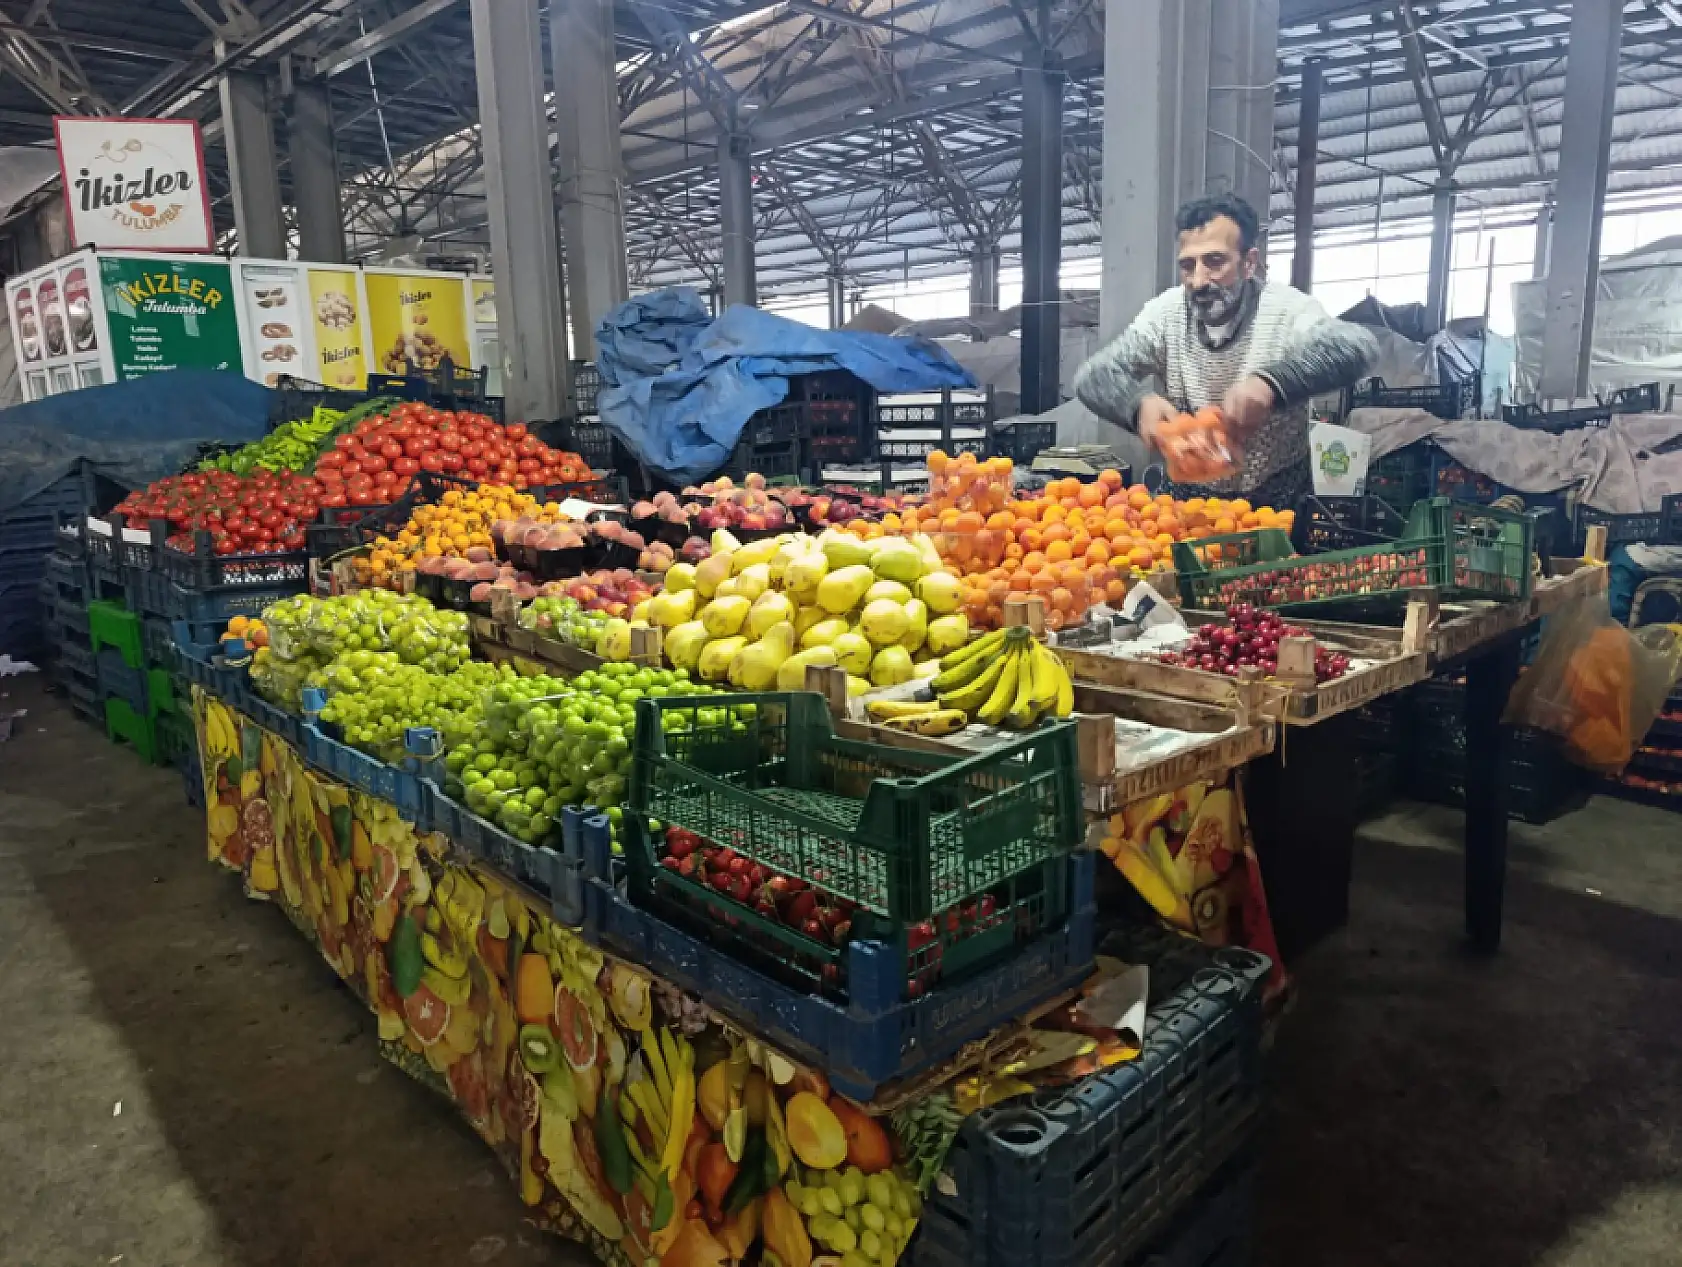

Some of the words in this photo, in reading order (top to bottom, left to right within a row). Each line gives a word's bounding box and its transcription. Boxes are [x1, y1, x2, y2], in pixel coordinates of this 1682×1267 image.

[74, 166, 194, 212] İkizler
[112, 202, 184, 230] TULUMBA
[116, 272, 222, 309] İKİZLER
